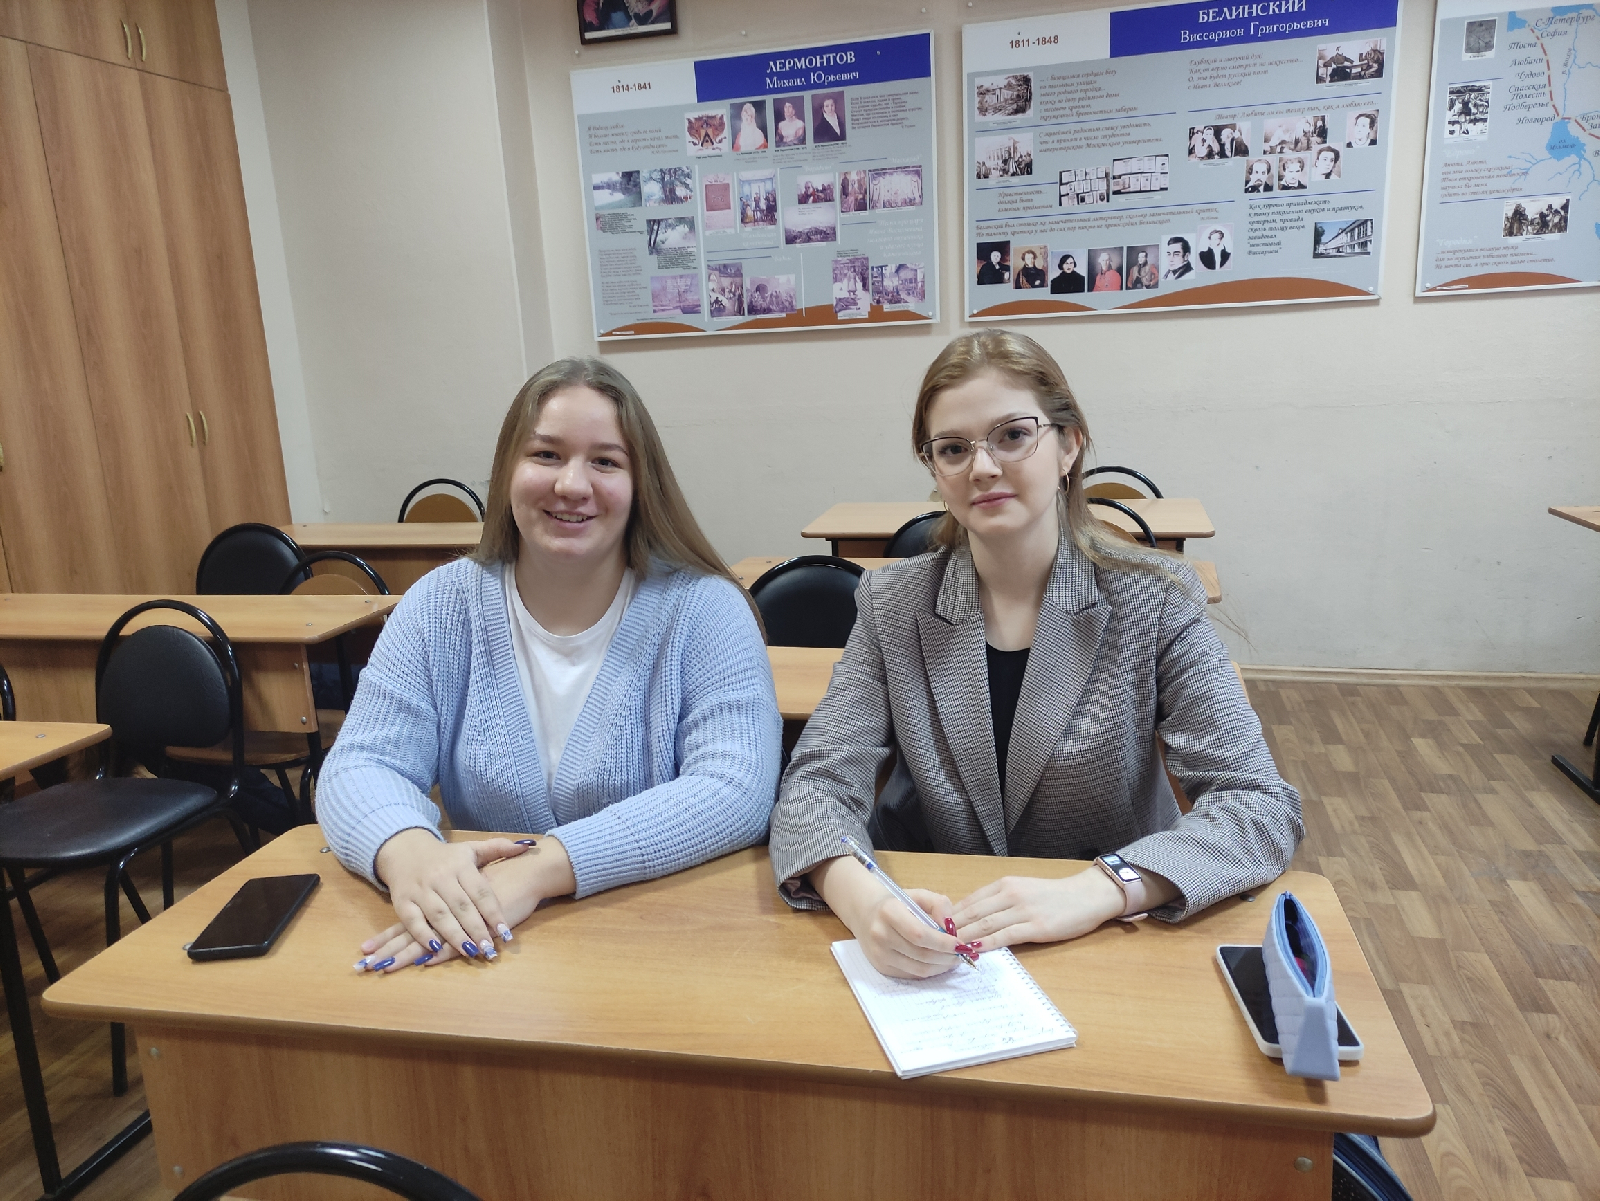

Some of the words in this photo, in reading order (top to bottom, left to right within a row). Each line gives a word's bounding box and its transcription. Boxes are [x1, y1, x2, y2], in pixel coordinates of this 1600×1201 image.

[1536, 13, 1596, 27] С-Петербург
[1181, 28, 1244, 42] Виссарион
[1250, 18, 1329, 37] Григорьевич
[1540, 29, 1568, 39] София
[1009, 35, 1059, 49] 1811-1848
[1508, 42, 1538, 50] Тосна
[767, 51, 855, 73] ЛЕРМОНТОВ
[1509, 56, 1544, 67] Любани
[765, 76, 806, 89] Михаил
[810, 70, 859, 87] Юрьевич
[1515, 71, 1545, 81] Чудово
[611, 82, 652, 94] 1814-1841
[1508, 84, 1546, 93] Спасская
[1511, 92, 1546, 101] Полесть
[1503, 102, 1550, 112] Подберезье
[1516, 114, 1556, 125] Новгород
